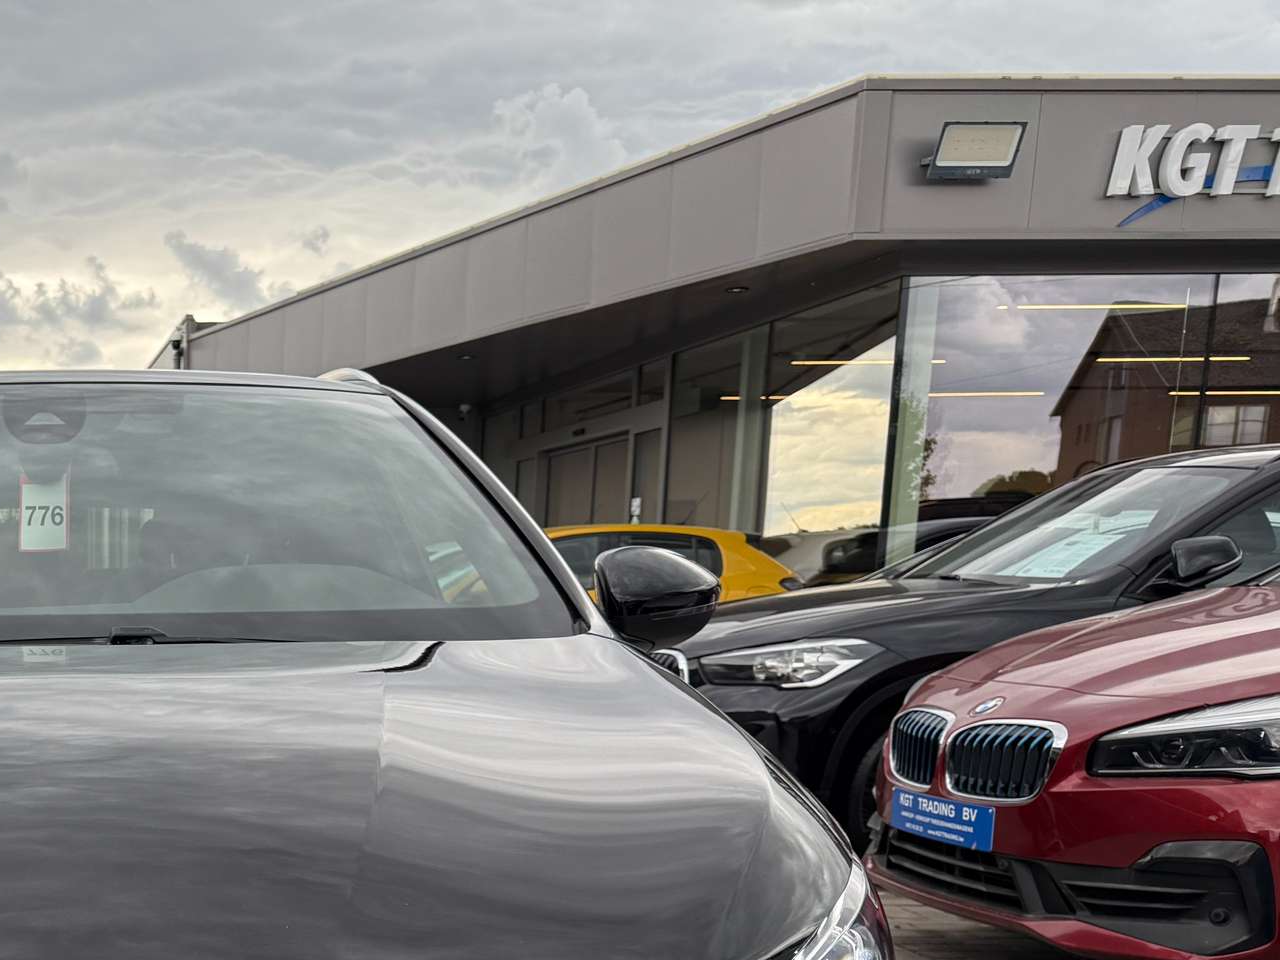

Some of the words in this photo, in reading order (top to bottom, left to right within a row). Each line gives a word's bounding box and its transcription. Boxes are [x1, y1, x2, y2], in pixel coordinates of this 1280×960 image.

[1106, 122, 1262, 197] KGT
[25, 506, 64, 527] 776
[899, 792, 914, 808] KGT
[918, 798, 955, 818] TRADING
[962, 807, 978, 822] BV
